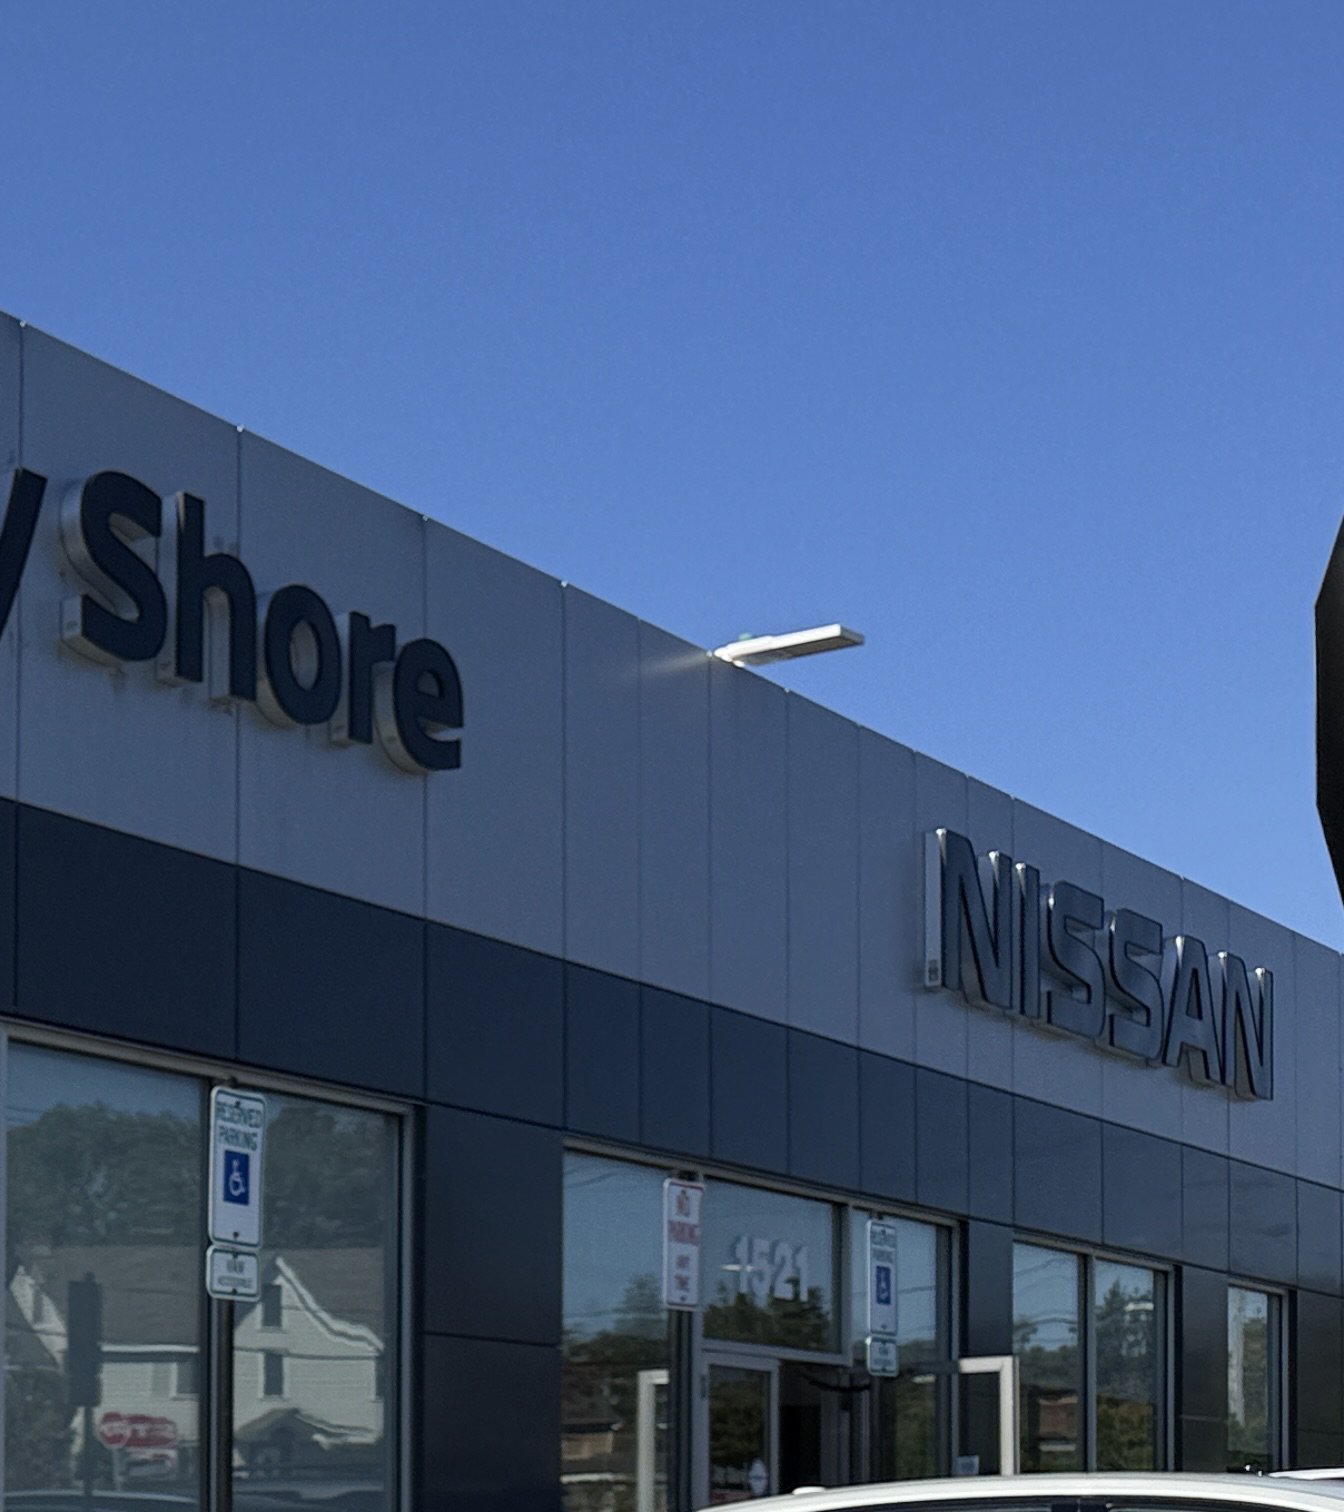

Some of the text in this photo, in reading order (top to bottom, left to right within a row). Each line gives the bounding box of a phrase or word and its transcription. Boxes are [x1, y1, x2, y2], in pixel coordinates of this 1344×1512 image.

[60, 470, 465, 774] Shore
[924, 827, 1274, 1100] NISSAN
[217, 1104, 263, 1129] RESERVED
[218, 1126, 258, 1151] PARKING
[733, 1235, 809, 1305] 1521
